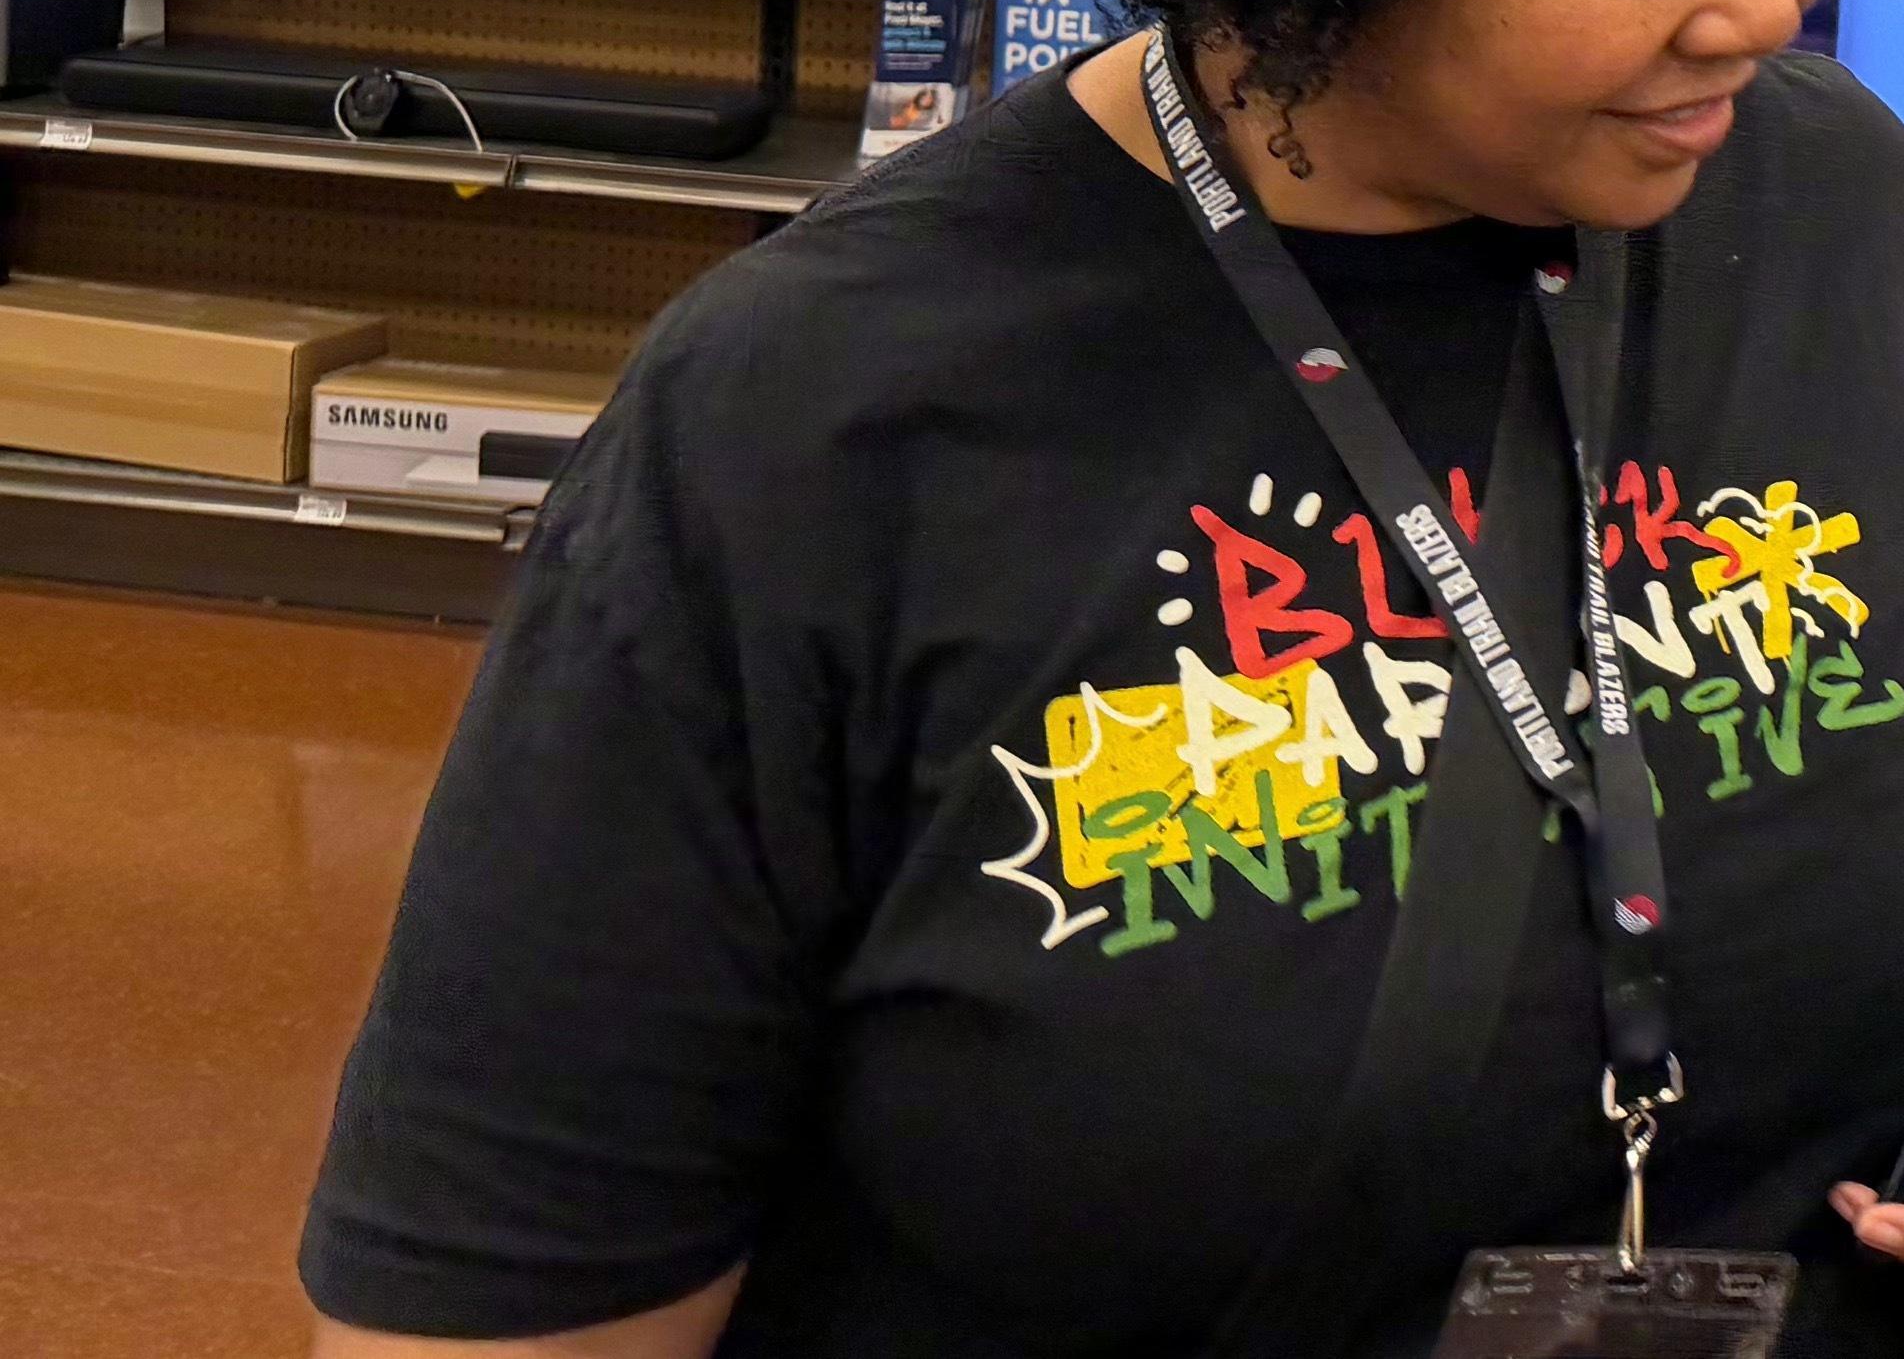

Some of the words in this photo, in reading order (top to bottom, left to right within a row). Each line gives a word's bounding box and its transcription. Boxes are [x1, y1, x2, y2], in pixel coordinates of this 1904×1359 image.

[1006, 5, 1102, 42] FUEL
[1171, 114, 1248, 233] PORTLAND
[327, 403, 449, 433] SAMSUNG
[1191, 459, 1741, 679] BLK
[1396, 503, 1480, 607] BLAZERS
[1455, 589, 1513, 669] TRAIL
[1486, 657, 1574, 781] PORTLAND
[1598, 631, 1631, 737] BLAZERS
